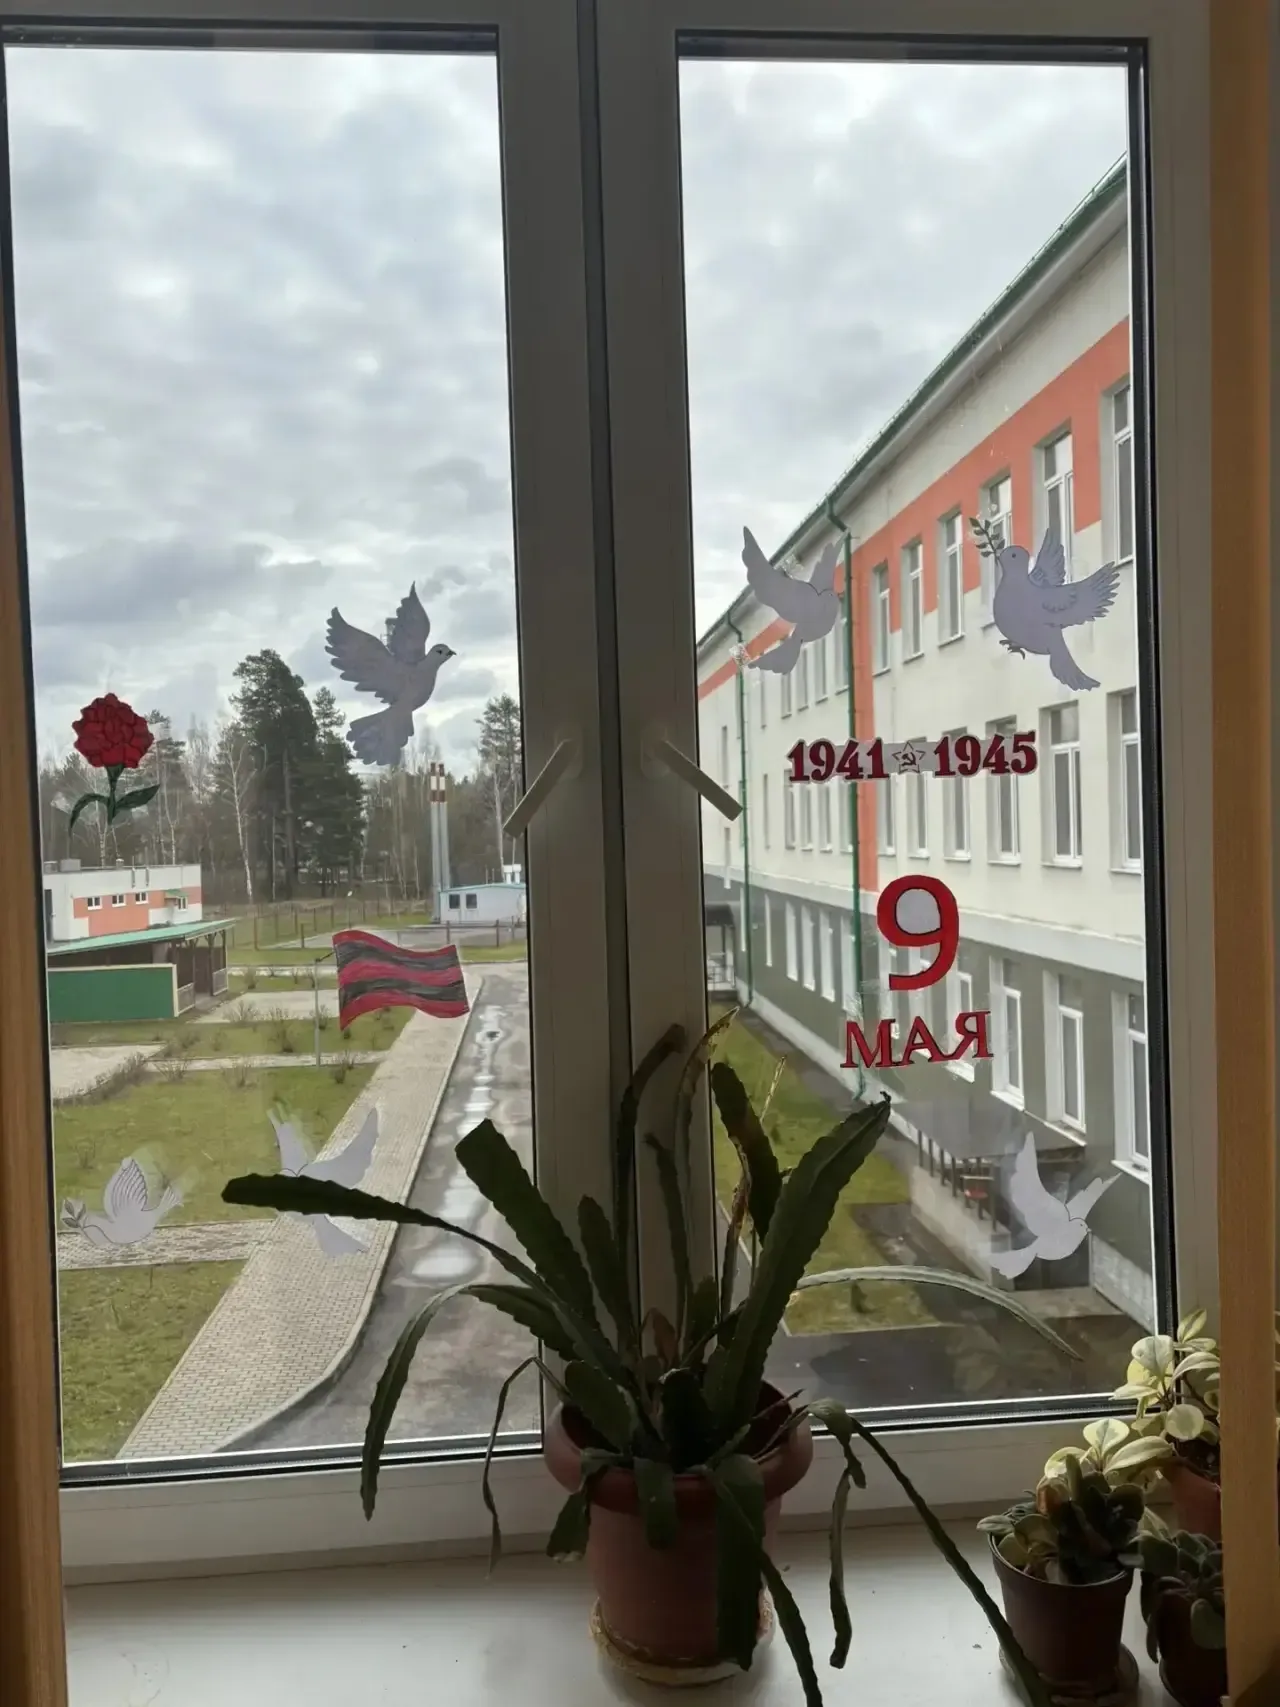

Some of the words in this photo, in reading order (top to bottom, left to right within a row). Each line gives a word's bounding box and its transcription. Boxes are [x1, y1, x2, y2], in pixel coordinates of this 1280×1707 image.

[787, 738, 889, 782] 1941
[933, 730, 1038, 777] 1945
[876, 874, 960, 991] 9
[840, 1010, 994, 1069] МАЯ
